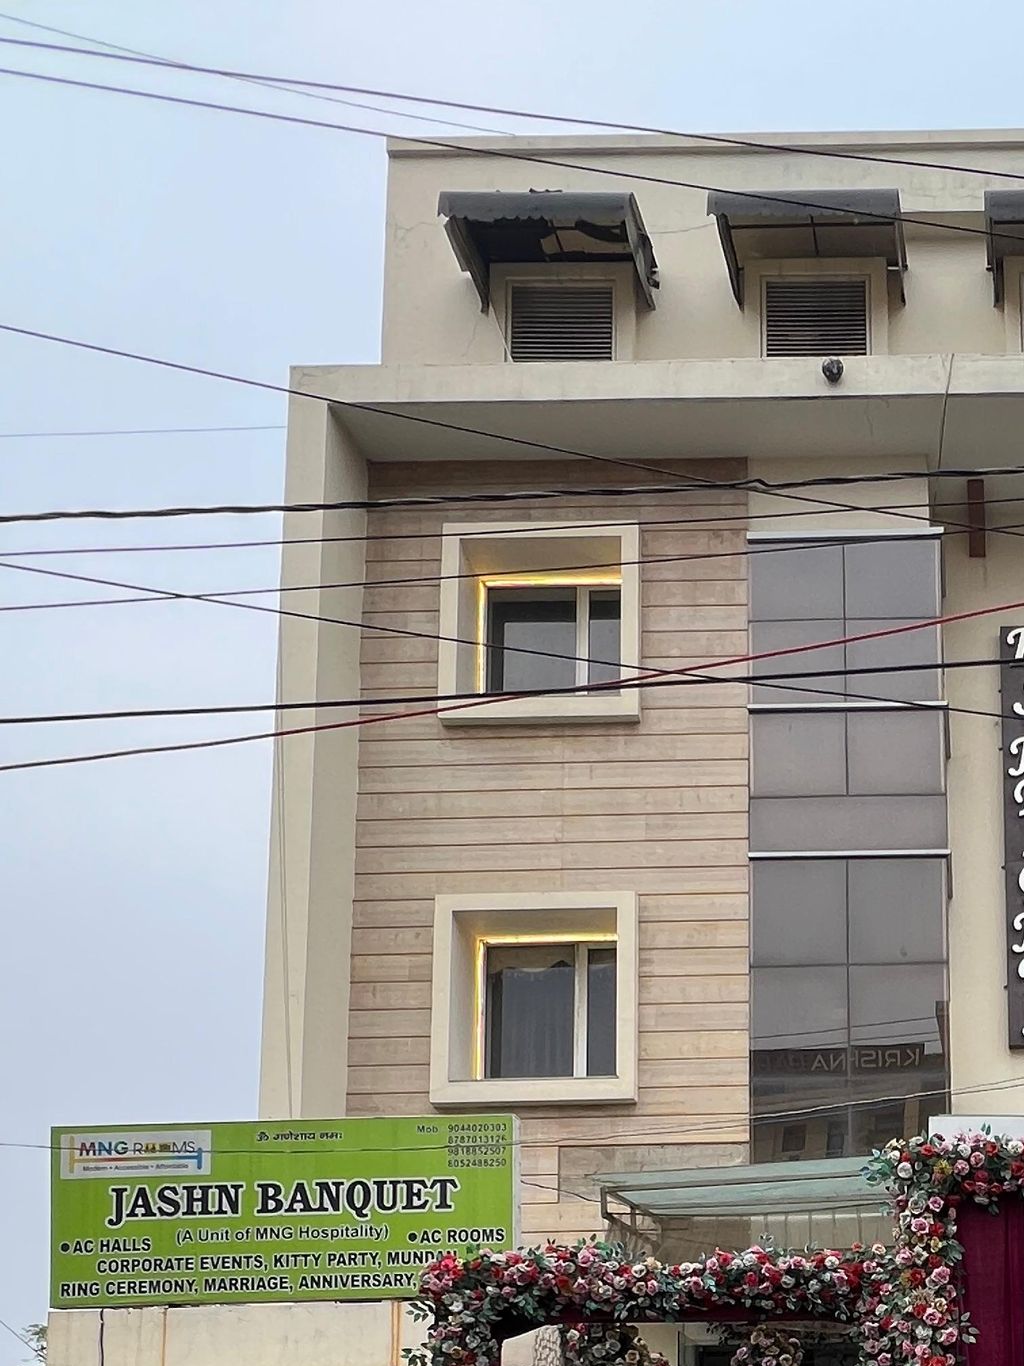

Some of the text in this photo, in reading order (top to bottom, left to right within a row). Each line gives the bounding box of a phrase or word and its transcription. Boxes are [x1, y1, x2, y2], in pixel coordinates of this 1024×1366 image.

[416, 1125, 439, 1133] Mob
[79, 1141, 129, 1157] MNG
[107, 1178, 458, 1227] JASHN BANQUET
[177, 1225, 389, 1246] (A Unit of MNG Hospitality)
[420, 1228, 505, 1244] AC ROOMS
[73, 1238, 151, 1254] AC HALLS
[97, 1258, 194, 1273] CORPORATE
[200, 1255, 268, 1271] EVENTS,
[274, 1253, 321, 1268] KITTY
[327, 1251, 382, 1268] PARTY,
[61, 1273, 417, 1297] RING CEREMONY, MARRIAGE, ANNIVERSARY,
